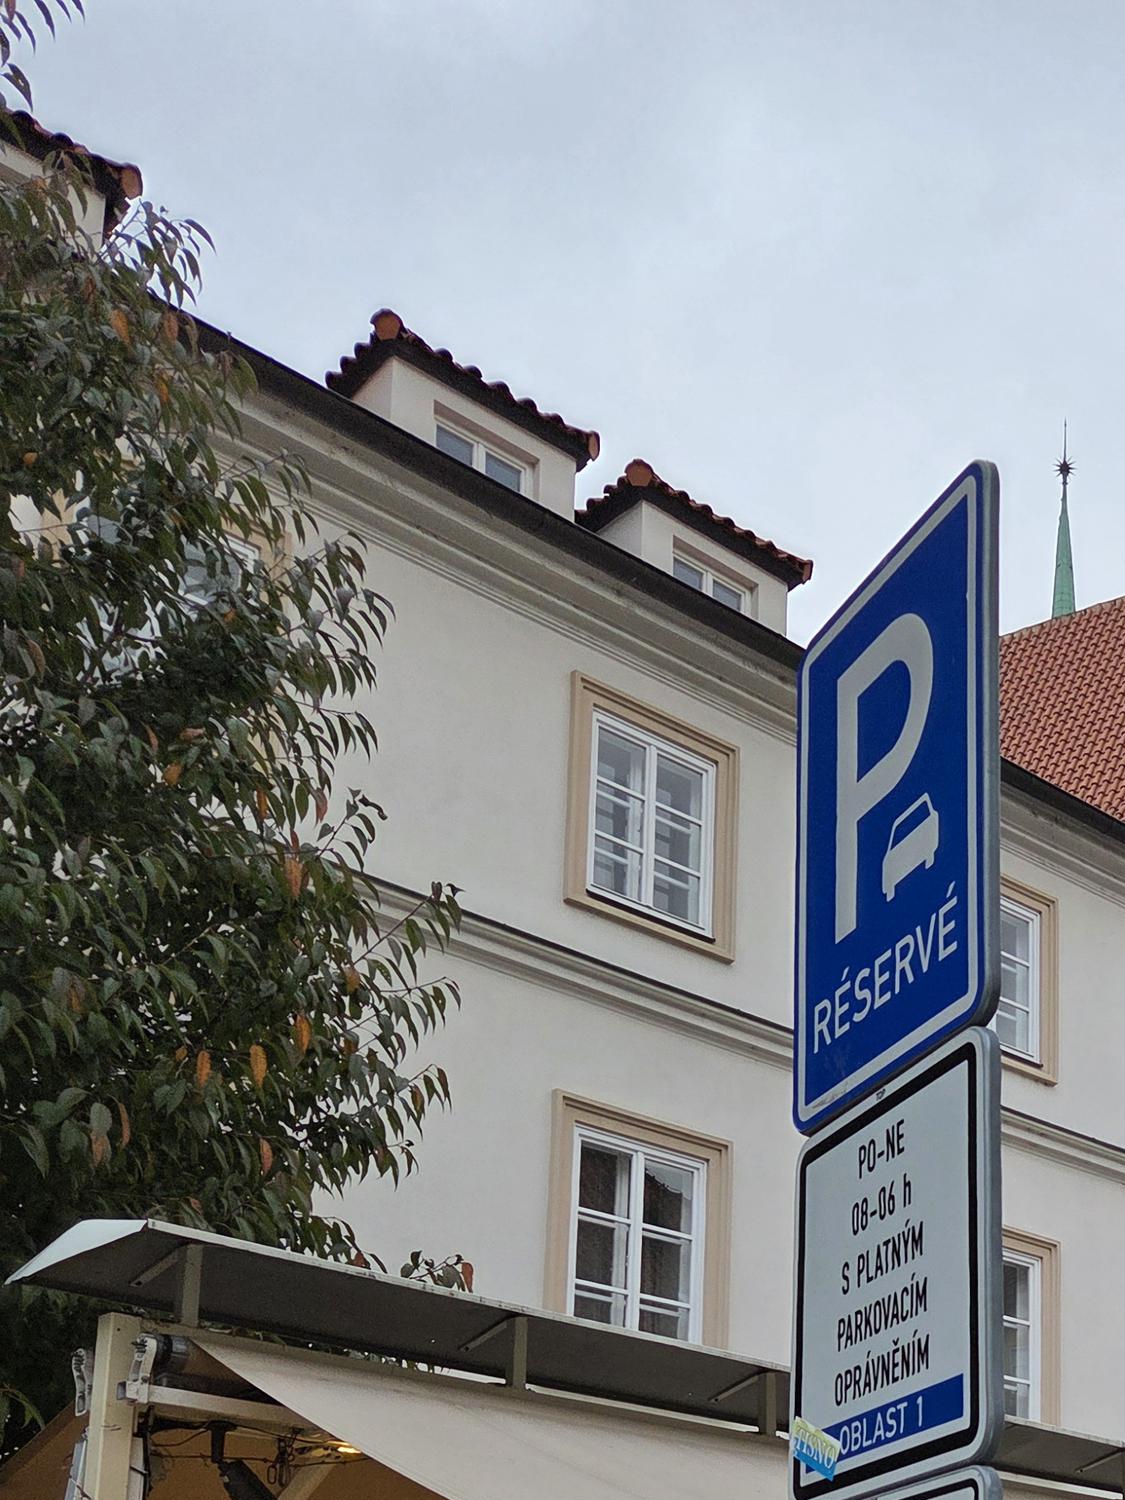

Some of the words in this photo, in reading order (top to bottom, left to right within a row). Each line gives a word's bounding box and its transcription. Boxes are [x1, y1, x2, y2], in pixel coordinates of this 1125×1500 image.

[835, 613, 933, 944] P
[814, 882, 960, 1054] RÉSERVÉ
[858, 1119, 905, 1179] PO-NE
[851, 1180, 896, 1236] 08-06
[902, 1173, 912, 1206] h
[841, 1262, 850, 1295] S
[857, 1218, 924, 1288] PLATNÝM
[838, 1272, 928, 1352] PARKOVACÍM
[834, 1329, 930, 1407] OPRÁVNĚNÍM
[840, 1402, 908, 1455] OBLAST
[916, 1396, 924, 1427] 1
